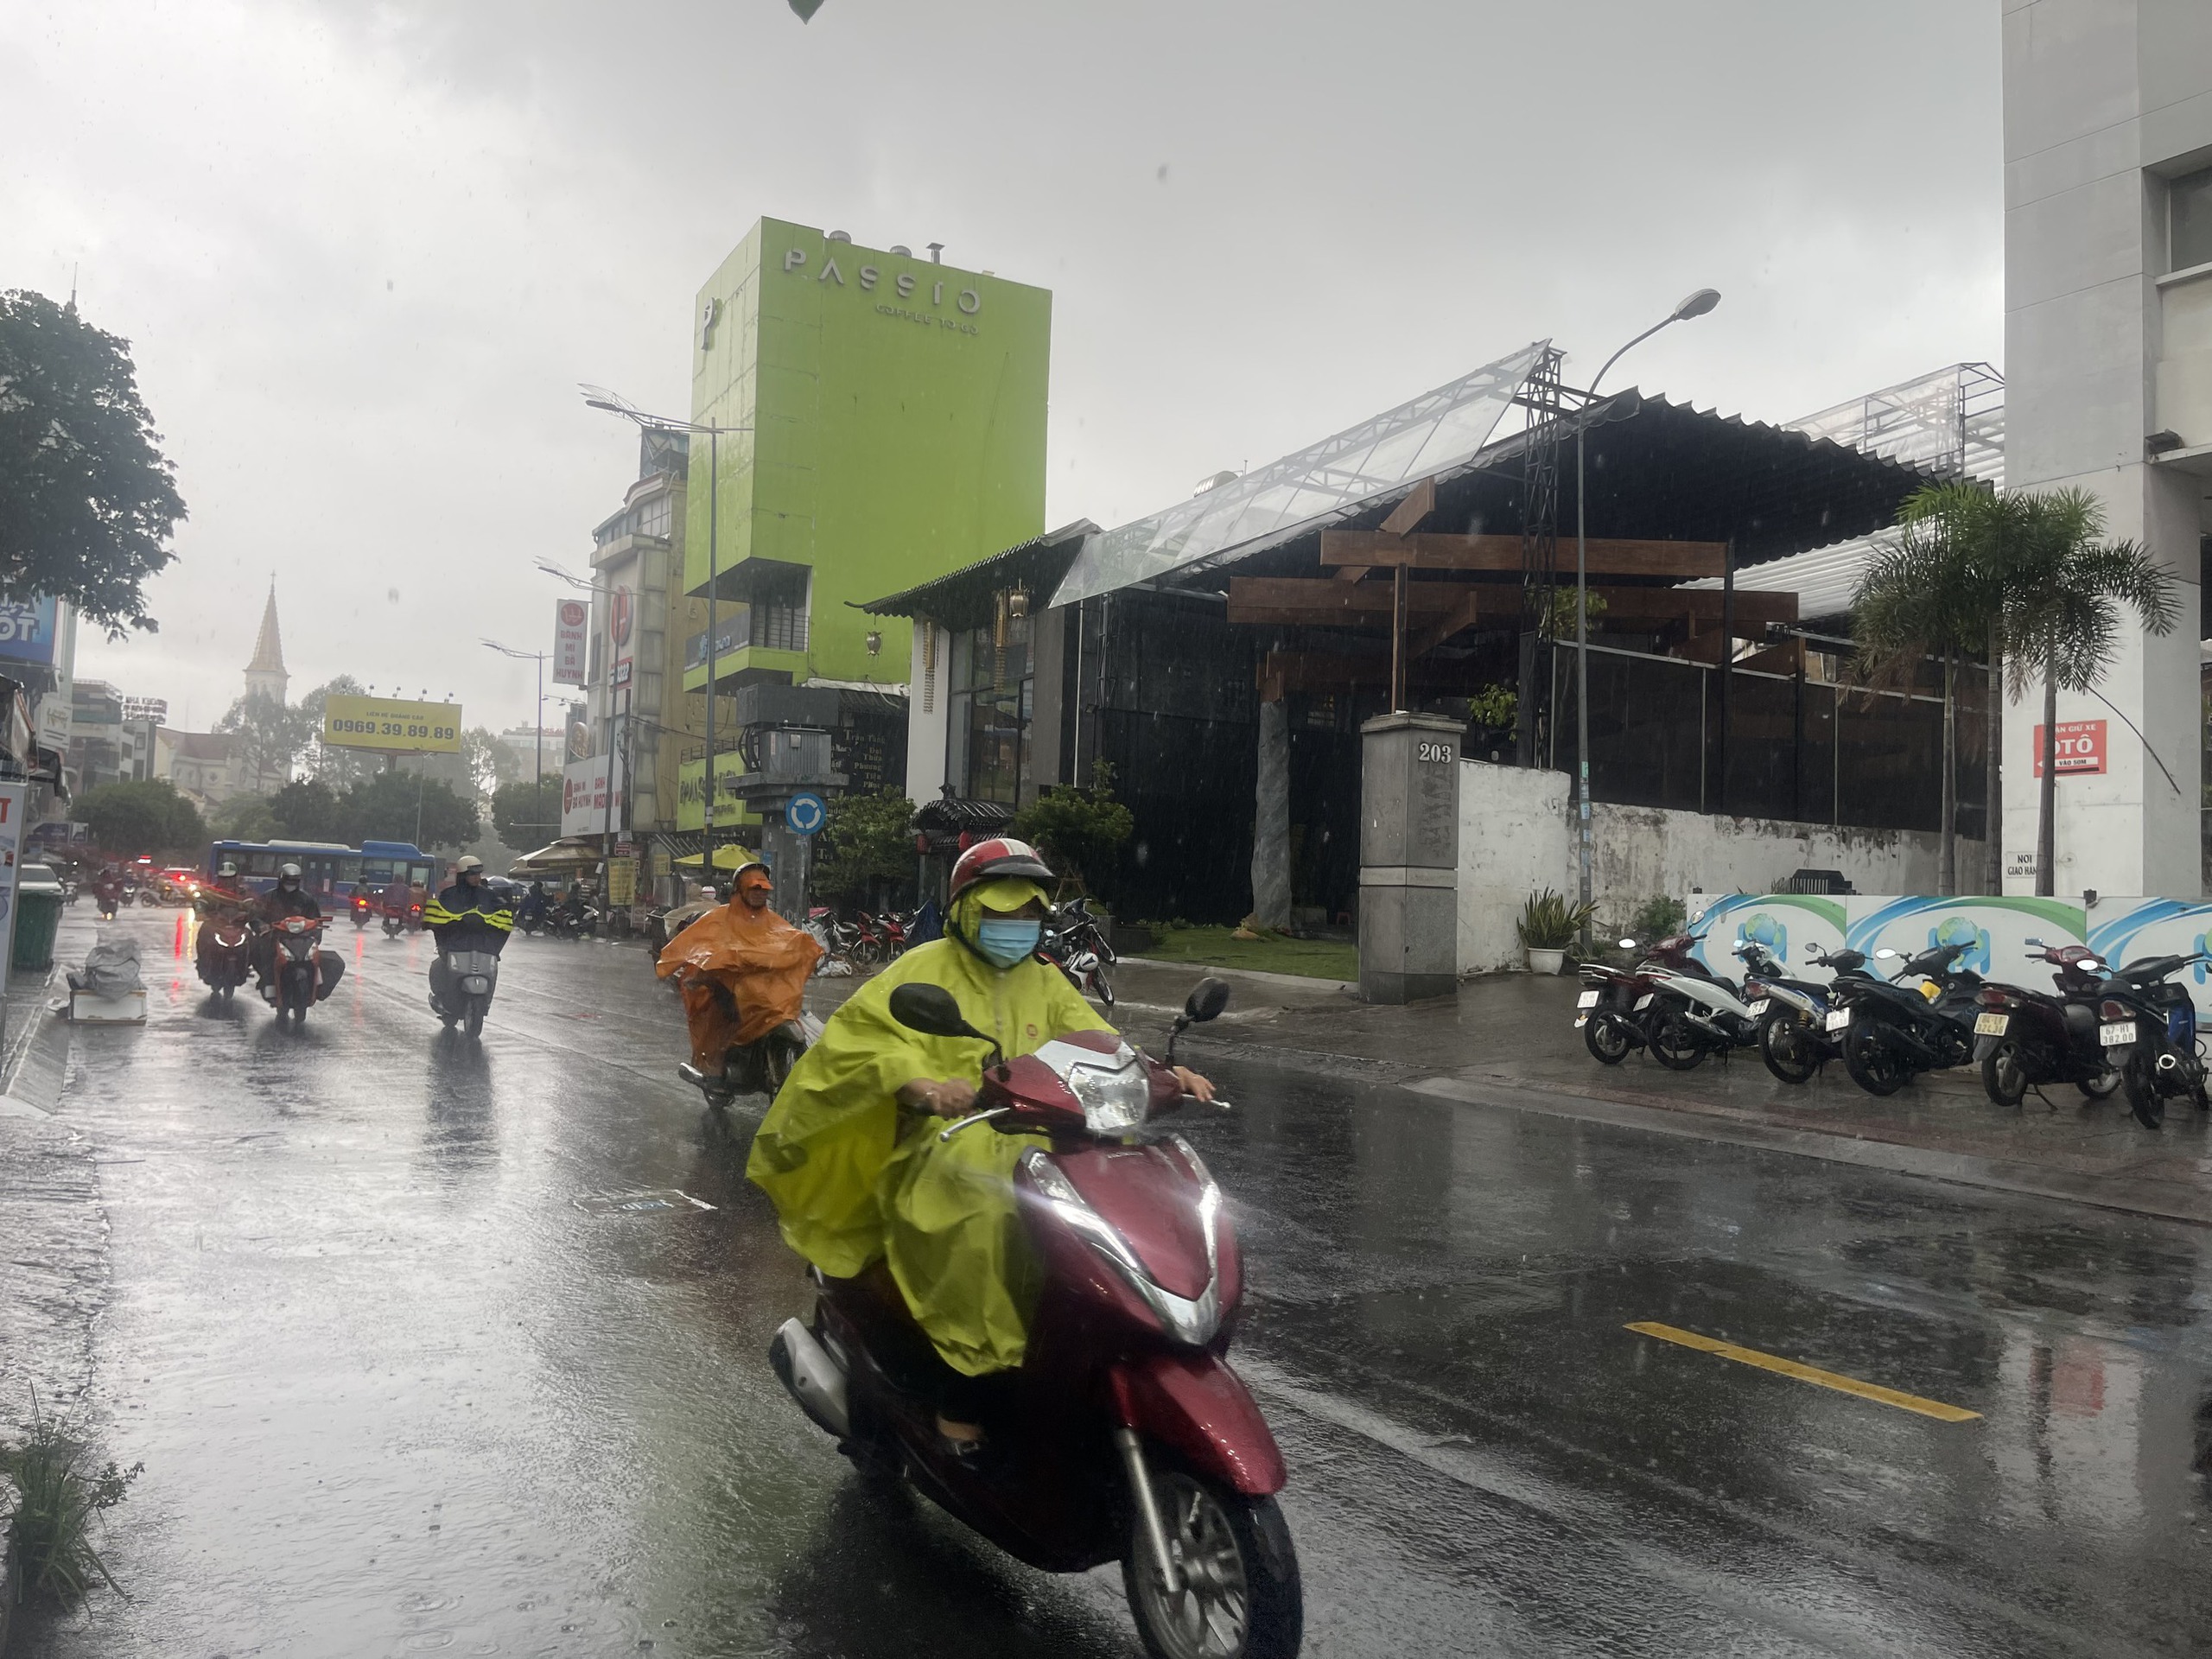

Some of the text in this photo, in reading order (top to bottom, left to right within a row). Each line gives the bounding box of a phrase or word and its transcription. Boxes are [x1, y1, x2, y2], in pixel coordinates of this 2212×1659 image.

[784, 247, 982, 315] PASSIO
[876, 303, 979, 334] COFFEE TO GO
[333, 719, 454, 740] 0969.39.89.89
[1418, 742, 1452, 764] 203
[2007, 866, 2024, 875] GIAO
